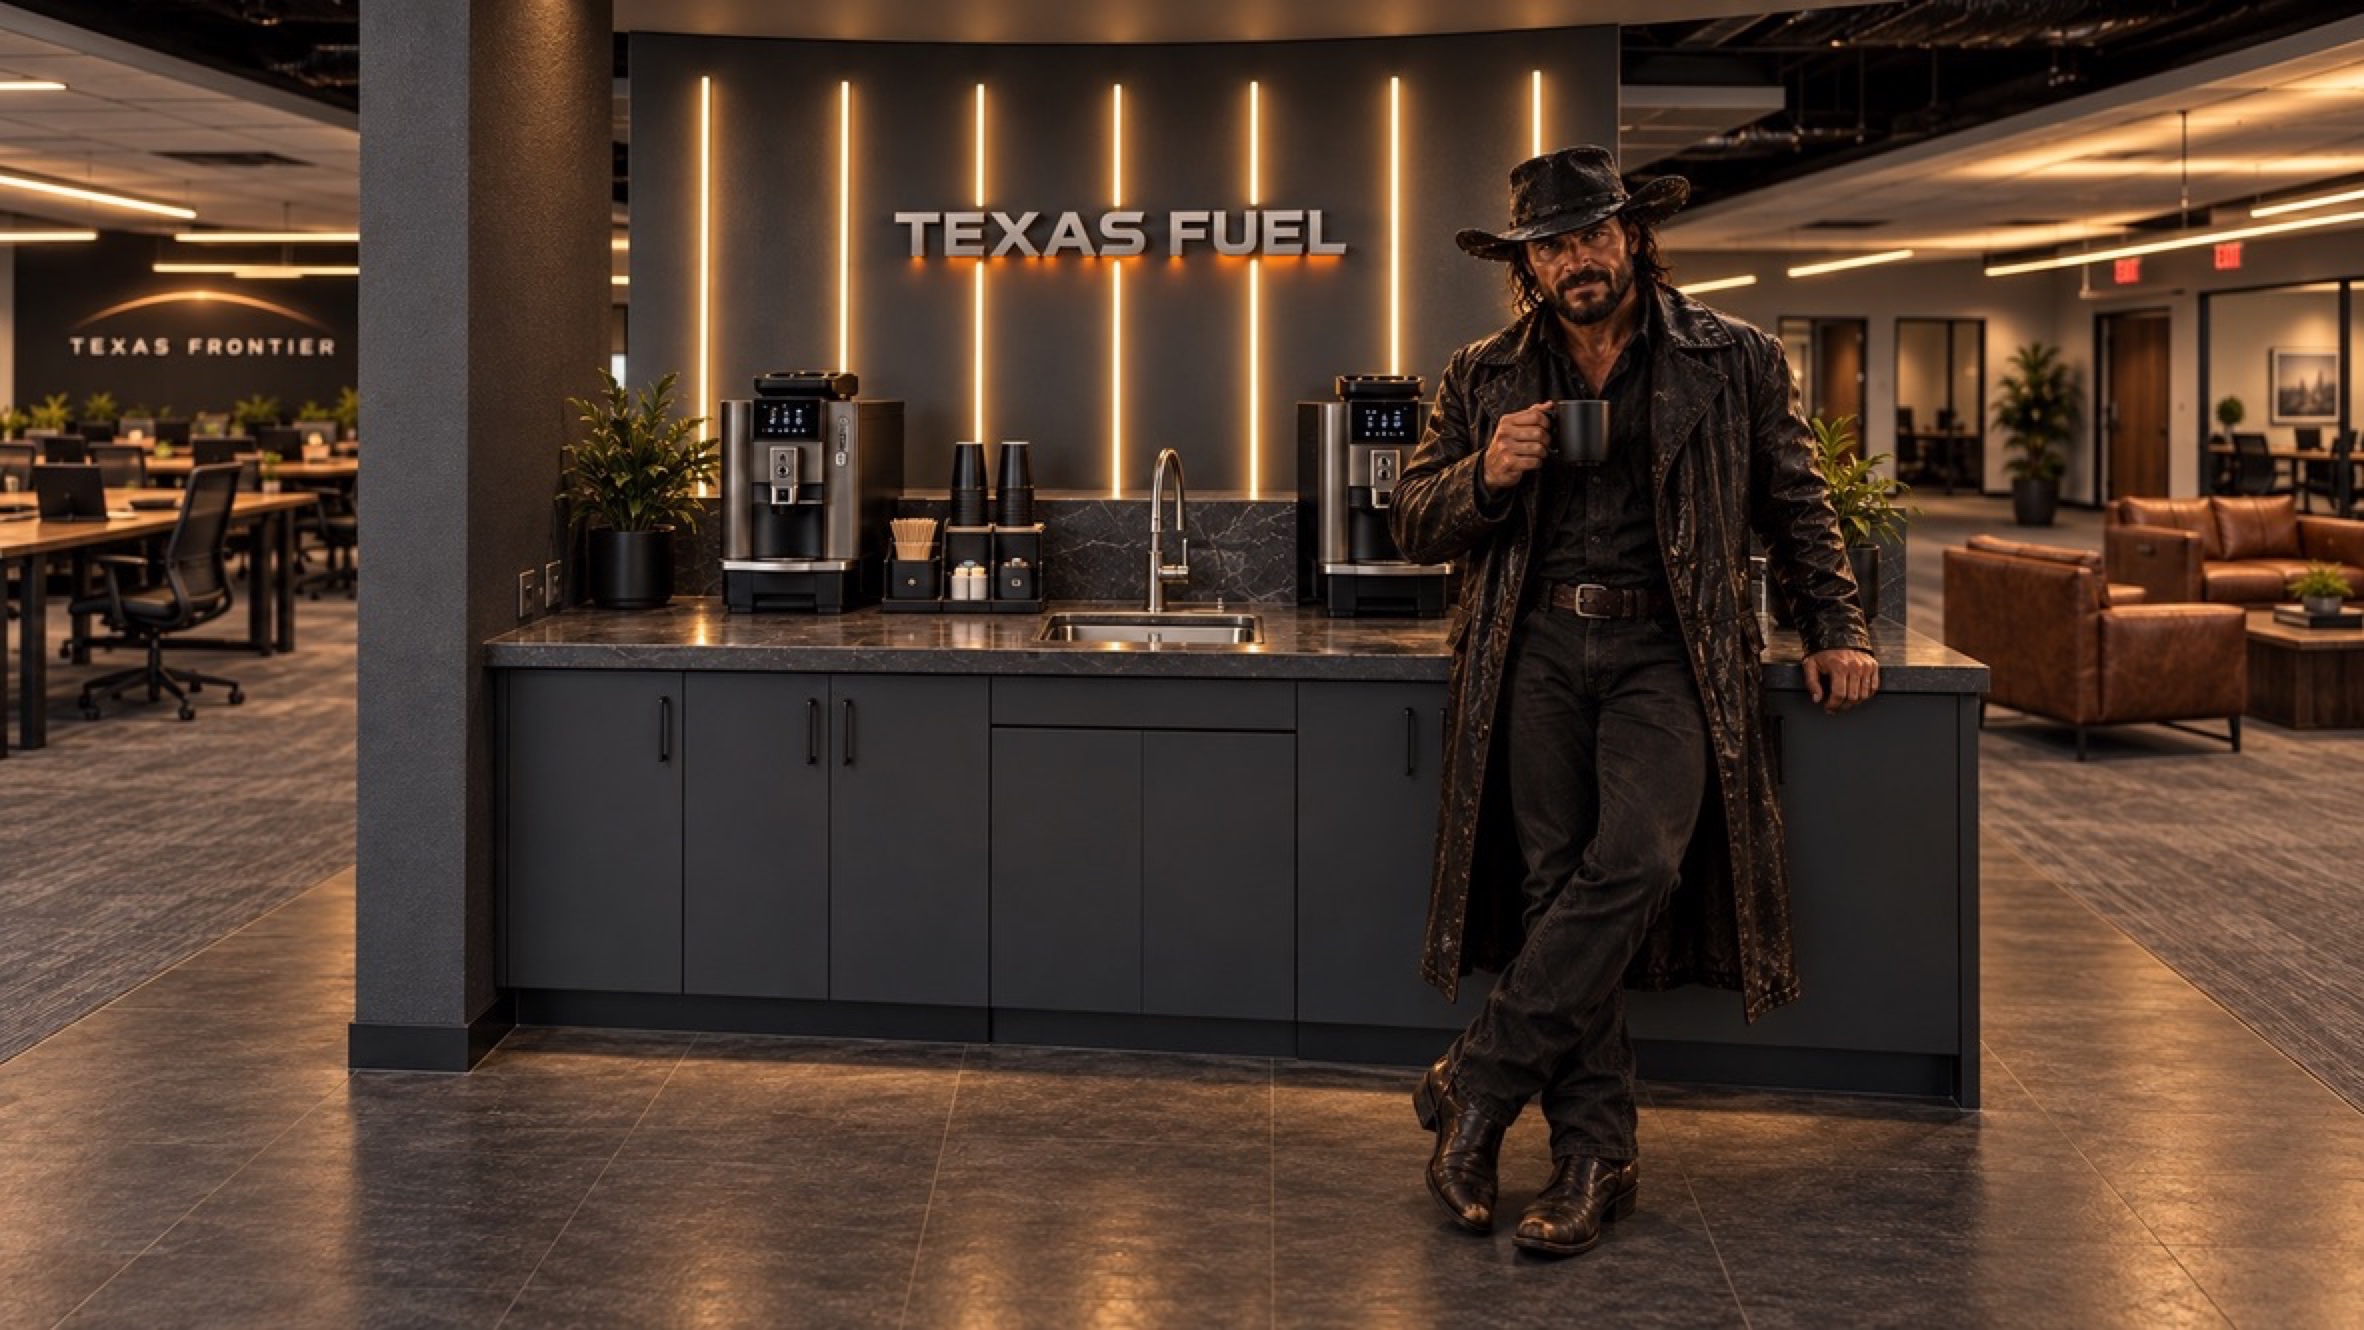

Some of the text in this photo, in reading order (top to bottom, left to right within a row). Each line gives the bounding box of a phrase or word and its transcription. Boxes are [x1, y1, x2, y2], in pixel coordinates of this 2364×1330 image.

[895, 209, 1347, 257] TEXAS FUEL
[69, 337, 336, 356] TEXAS FRONTIER
